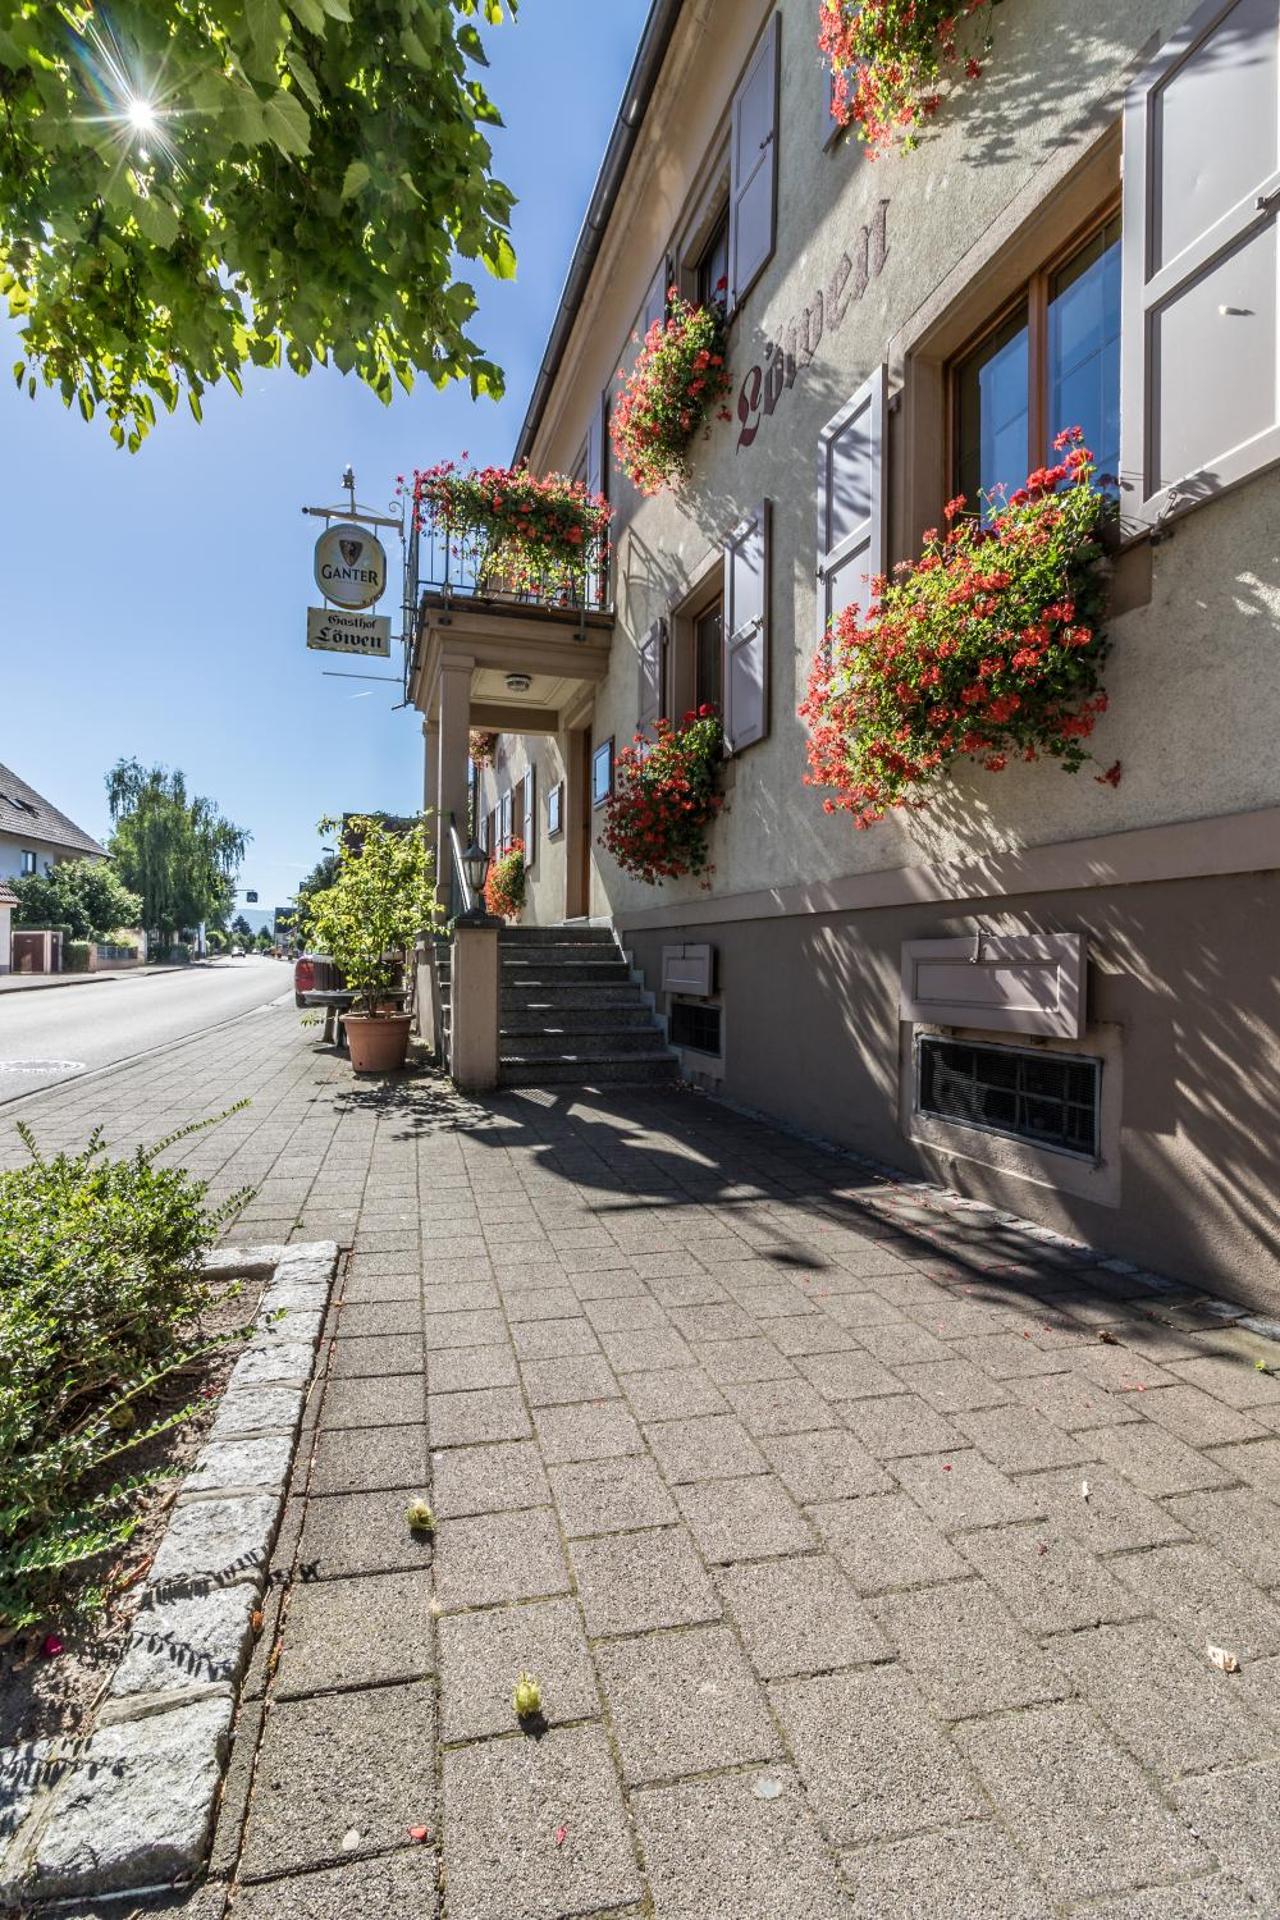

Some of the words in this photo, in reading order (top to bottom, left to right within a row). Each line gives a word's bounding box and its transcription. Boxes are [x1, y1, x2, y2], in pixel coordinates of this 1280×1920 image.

[736, 199, 890, 455] Löwen
[322, 564, 378, 586] GANTER
[328, 614, 376, 630] Gasthof
[315, 628, 382, 648] Löwen
